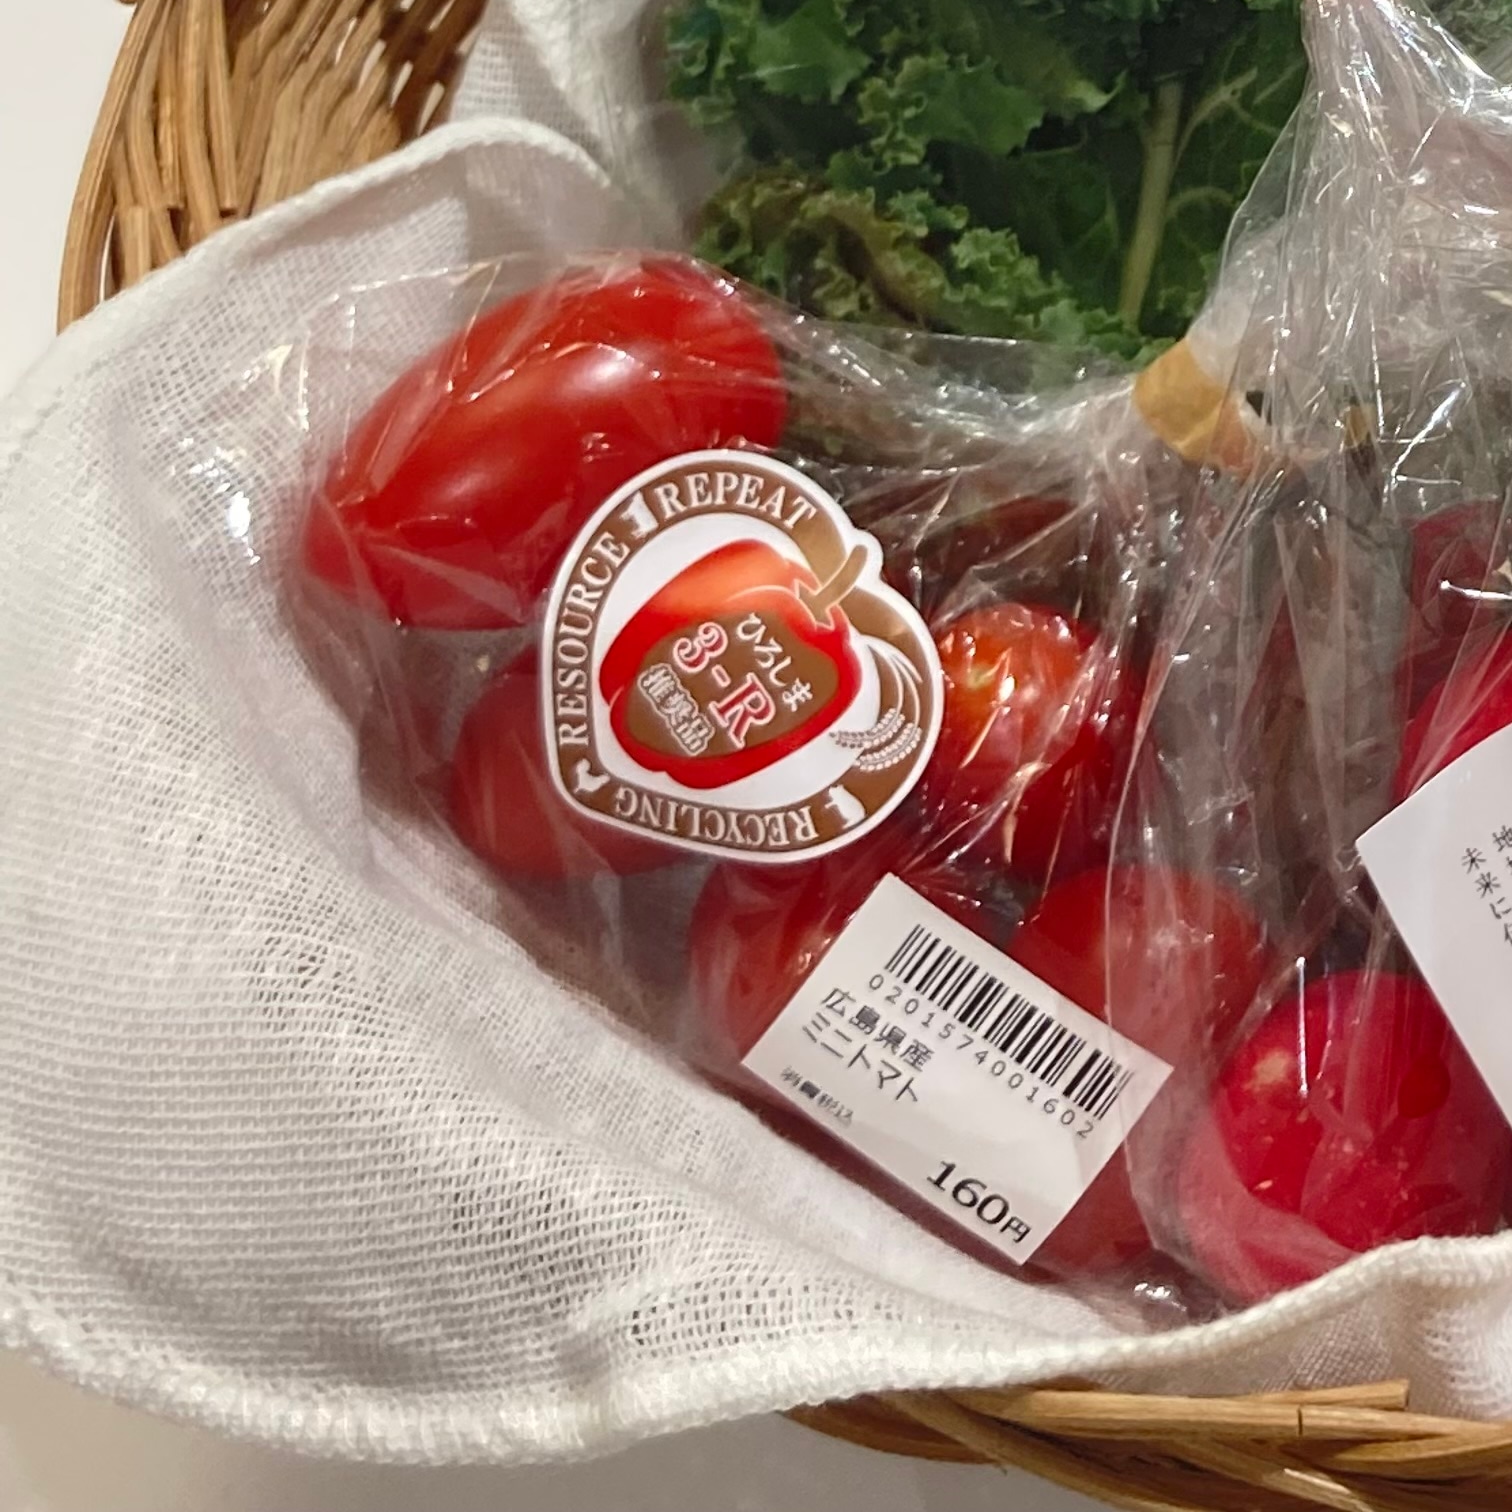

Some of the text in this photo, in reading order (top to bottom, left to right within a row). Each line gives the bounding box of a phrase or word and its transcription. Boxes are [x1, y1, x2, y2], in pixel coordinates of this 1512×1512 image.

[654, 471, 818, 531] REPEAT
[556, 532, 630, 747] RESOURCE
[736, 612, 814, 713] ひろしま
[616, 786, 820, 848] RECYCLING
[801, 1011, 918, 1103] ミニトマト
[821, 987, 935, 1073] 広島県産
[867, 973, 1096, 1140] 0201574001602
[926, 1160, 1032, 1244] 160円
